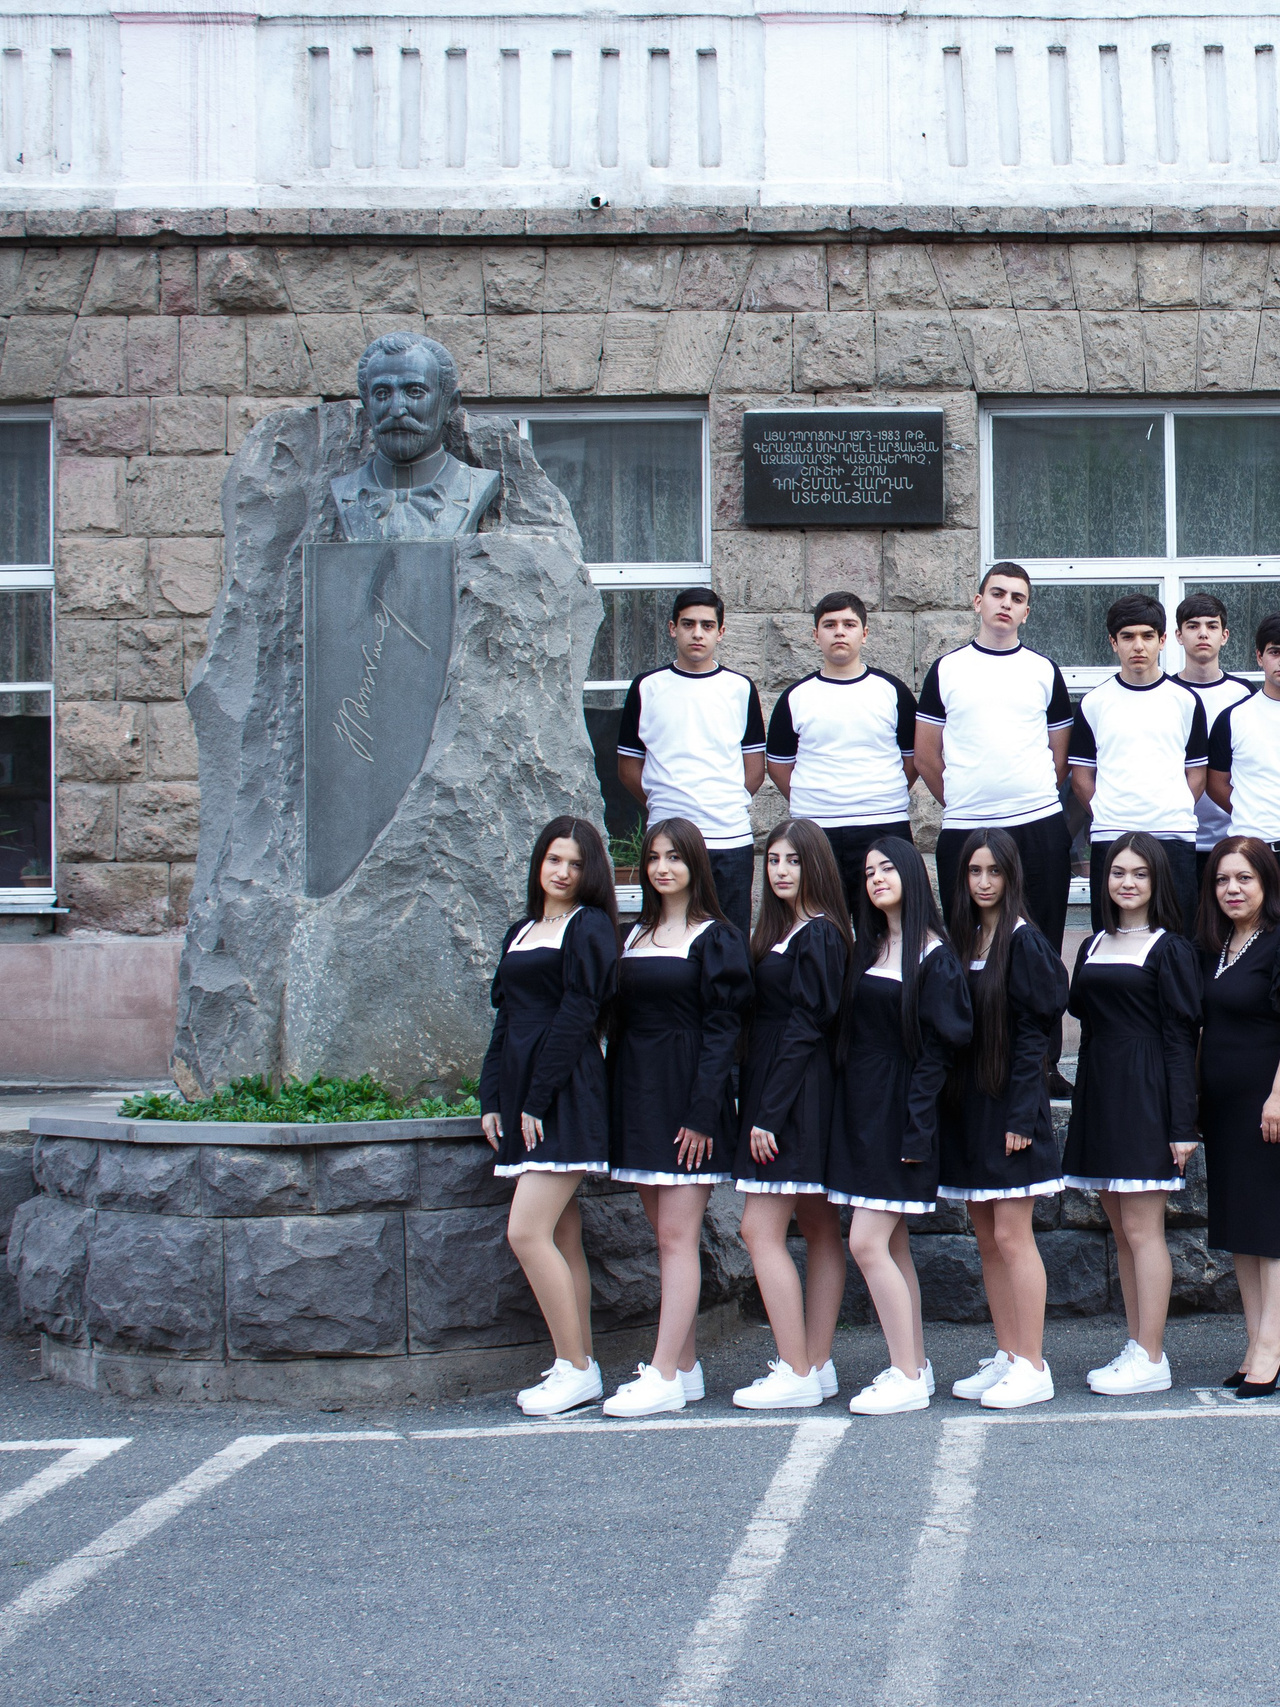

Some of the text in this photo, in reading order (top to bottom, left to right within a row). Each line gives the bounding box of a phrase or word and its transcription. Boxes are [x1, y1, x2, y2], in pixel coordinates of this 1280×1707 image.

[763, 430, 927, 441] ԱՅՍ ԴՊՐՈՑՈՒՄ 1973-1983 ԹԹ.
[753, 442, 939, 453] ԳԵՐԱԶԱՆՑ ՍՈՎՈՐԵԼ Է ԱՐՑԱԽՅԱՆ
[761, 454, 836, 465] ԱԶԱՏԱՄԱՐՏԻ
[801, 466, 887, 476] ՇՈՒՇԻԻ ՀԵՐՈՍ
[773, 477, 842, 490] ԴՈՒՇՄԱՆ
[854, 477, 913, 490] ՎԱՐԴԱՆ
[791, 491, 892, 505] ՍՏԵՓԱՆՅԱՆԸ
